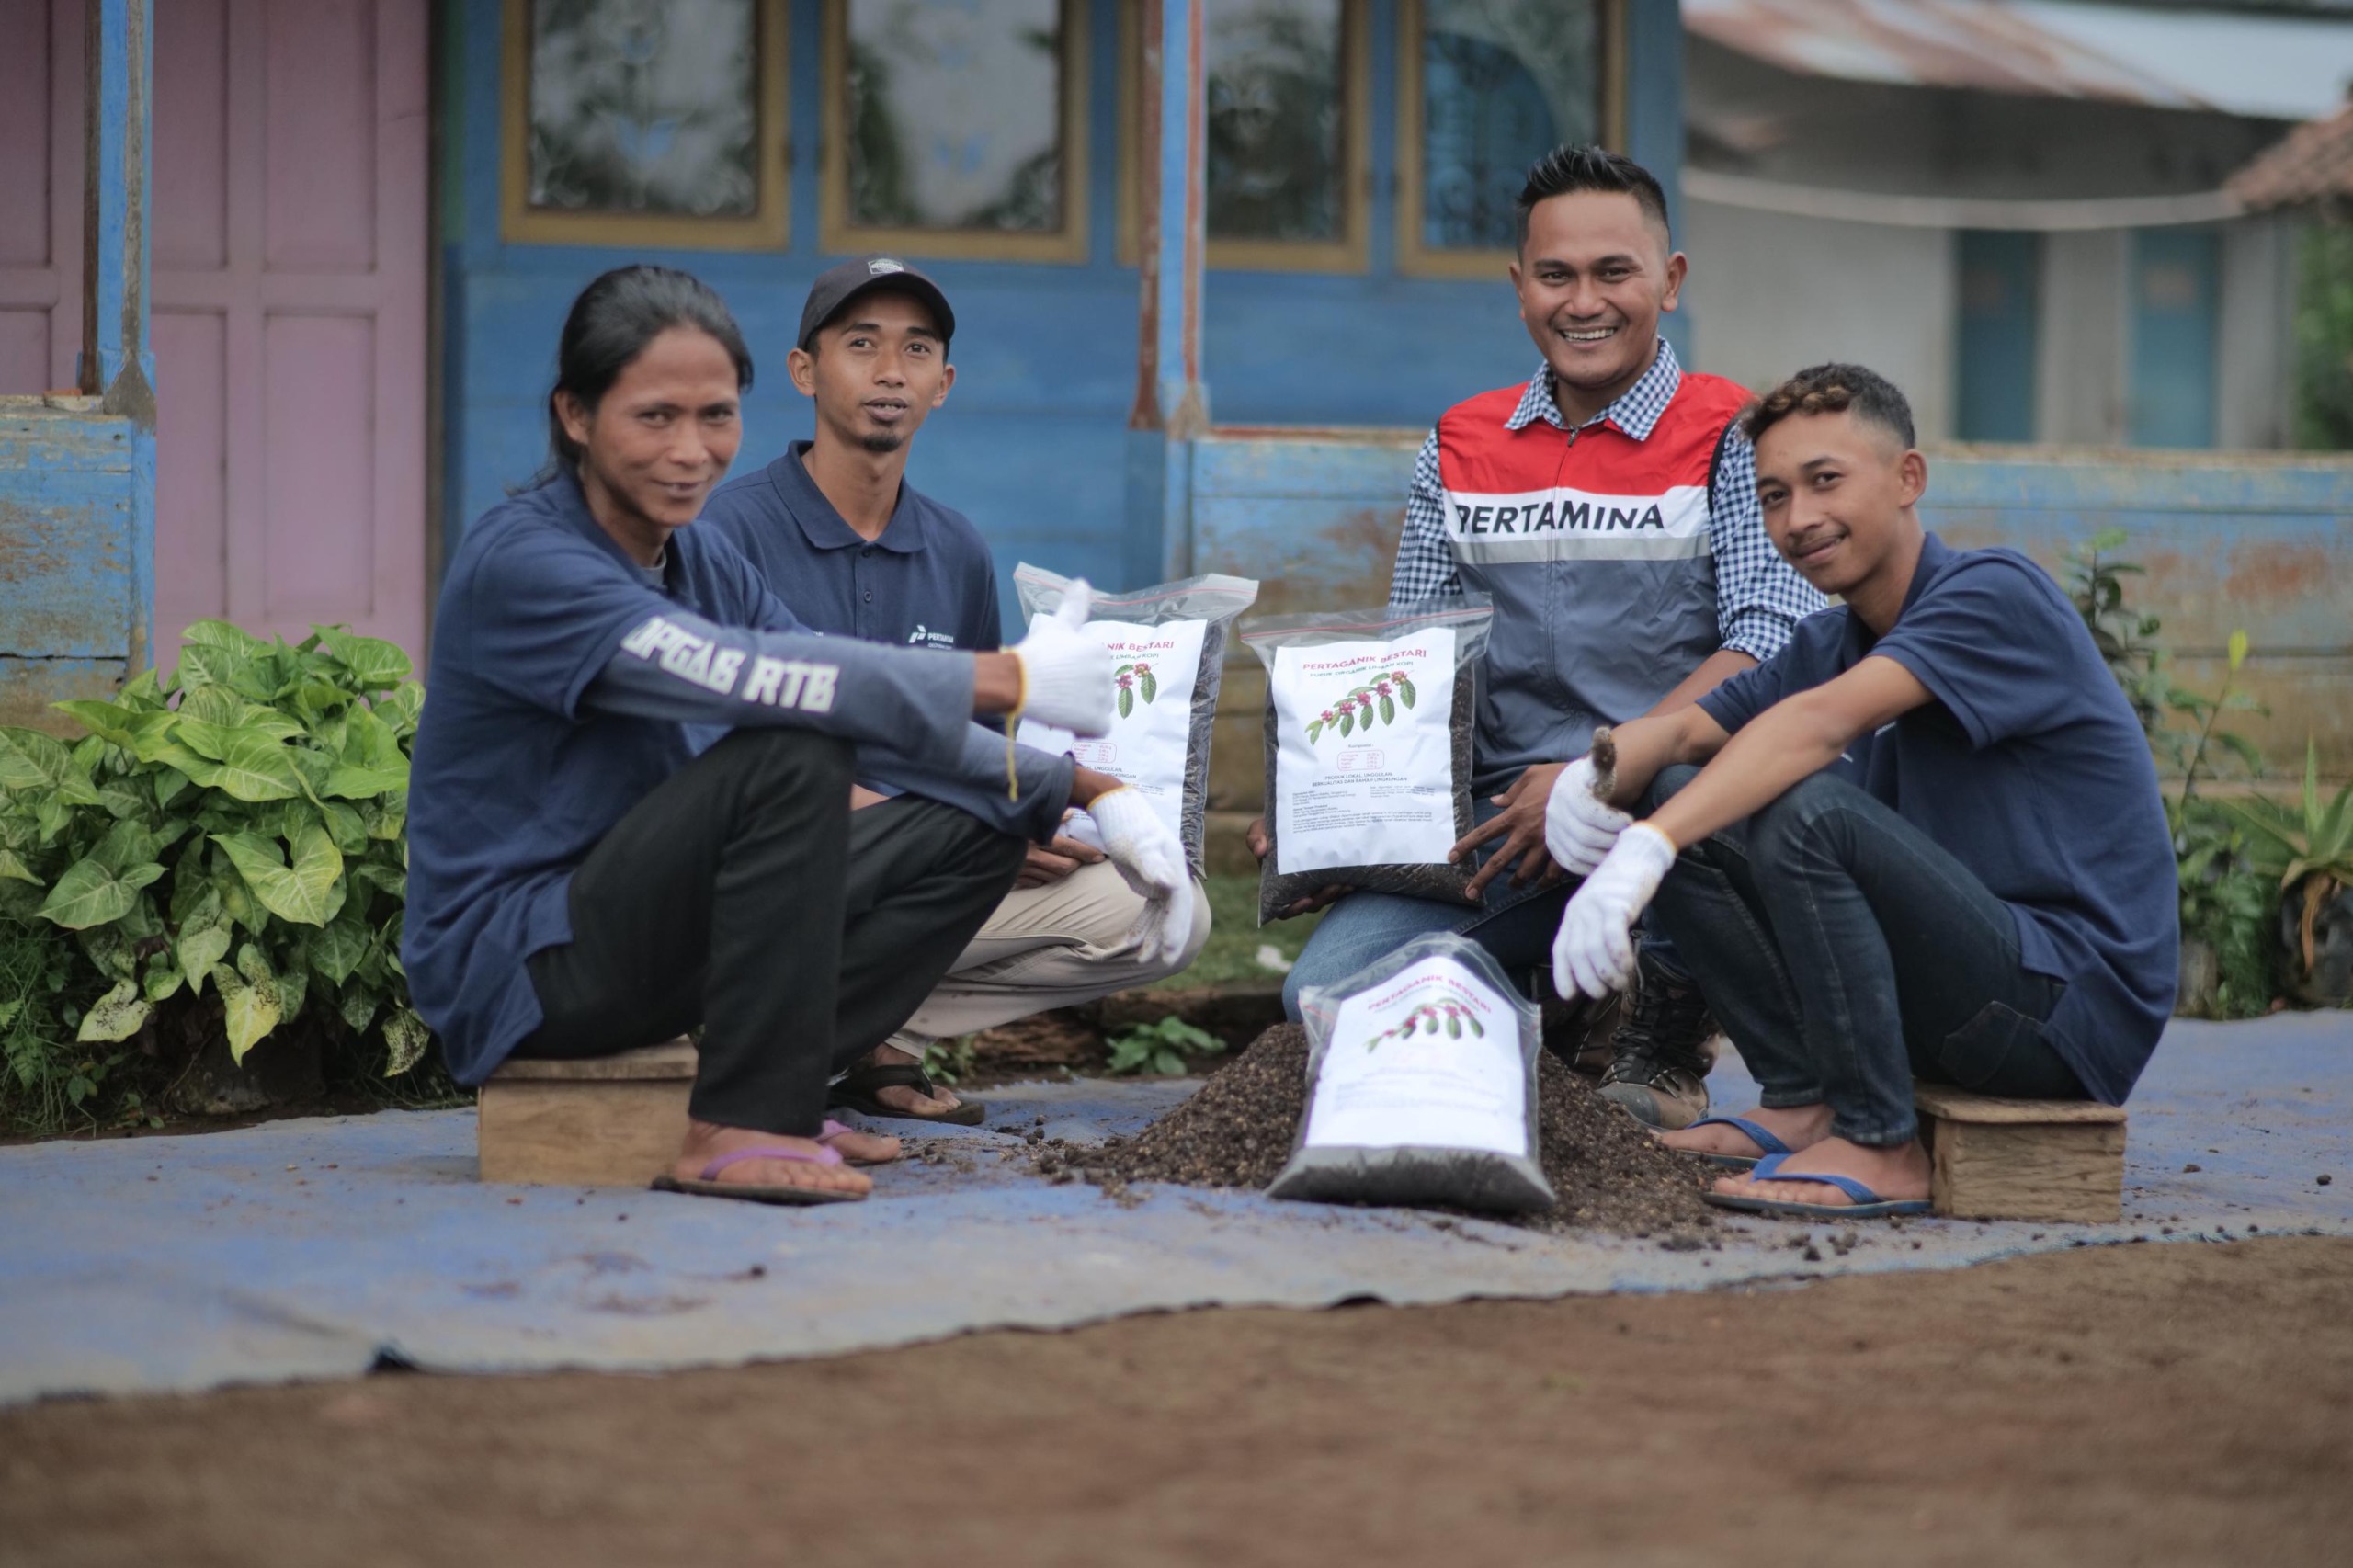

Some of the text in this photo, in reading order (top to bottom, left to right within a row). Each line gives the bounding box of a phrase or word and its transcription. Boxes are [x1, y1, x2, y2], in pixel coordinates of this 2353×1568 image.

[1453, 500, 1665, 534] PERTAMINA
[1129, 641, 1175, 652] BESTARI
[1302, 648, 1427, 670] PERTAGANIK BESTARI
[742, 656, 840, 713] RTB
